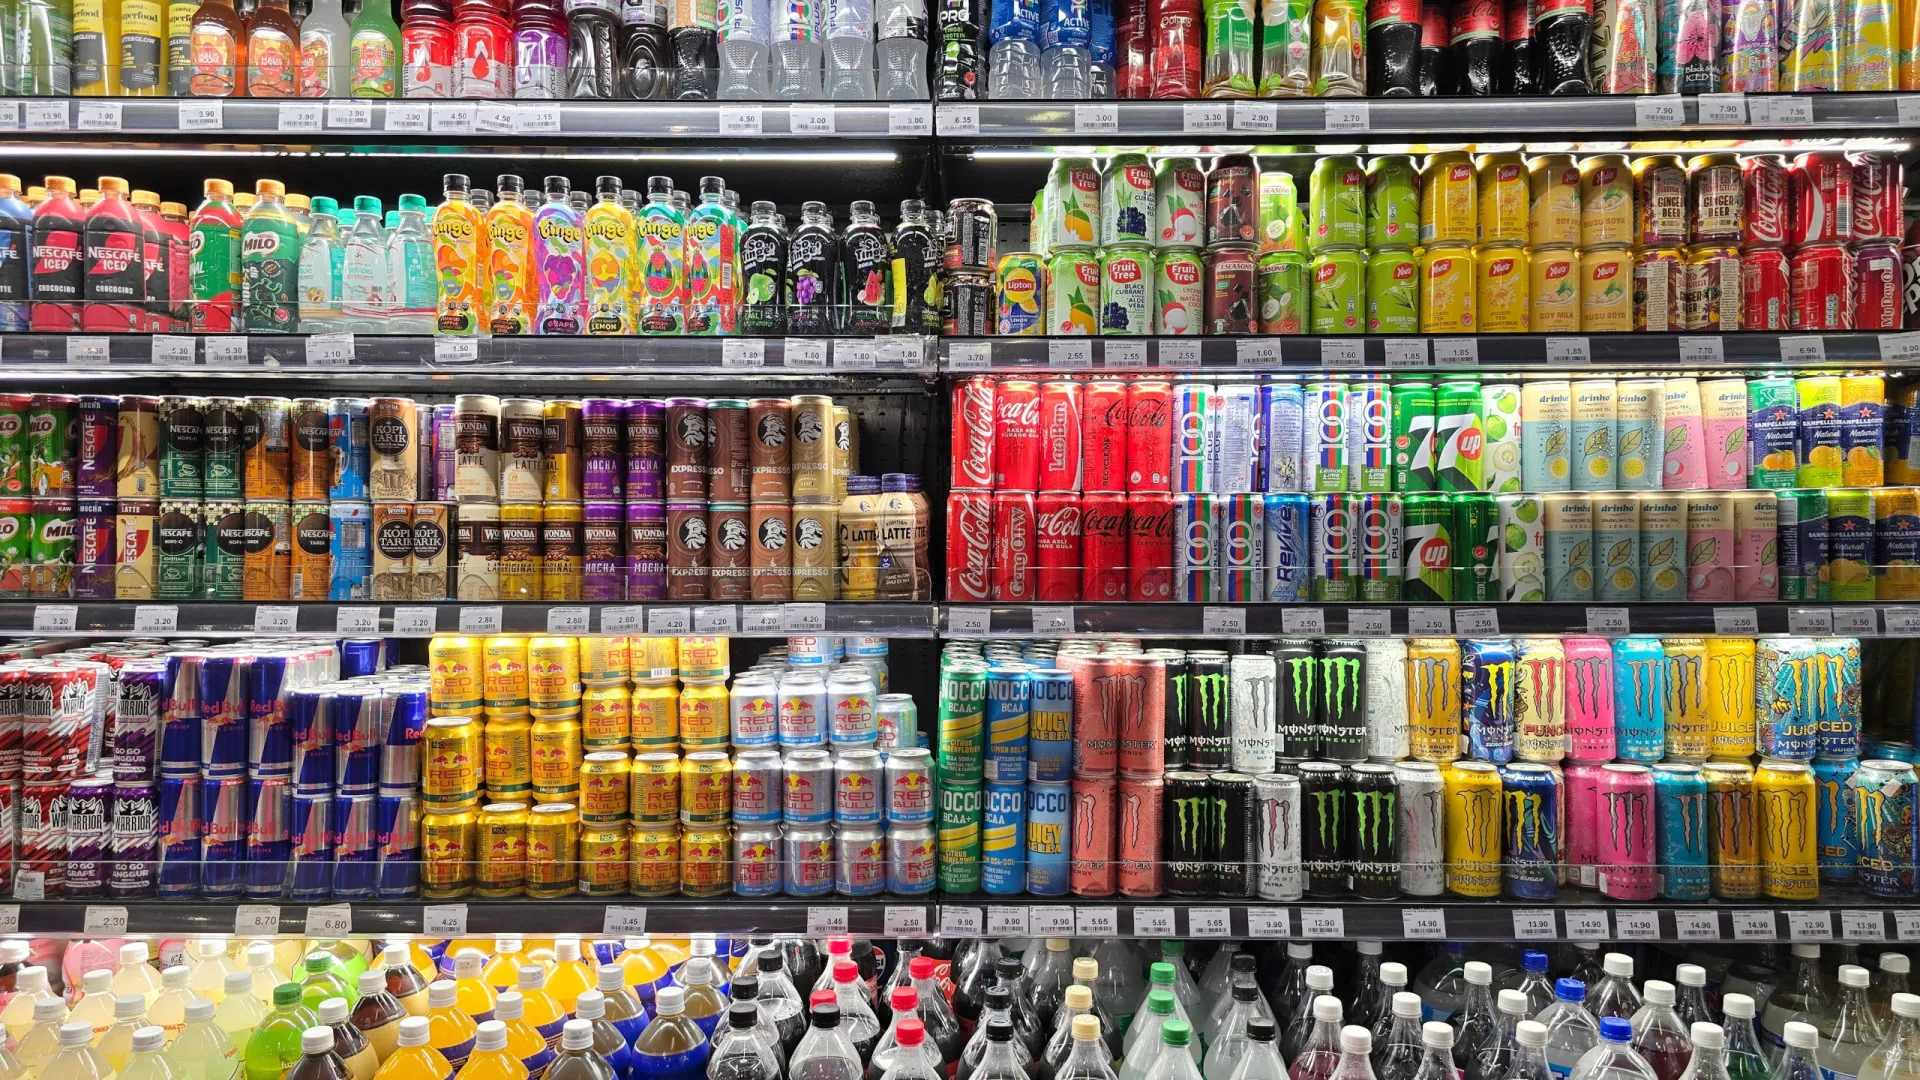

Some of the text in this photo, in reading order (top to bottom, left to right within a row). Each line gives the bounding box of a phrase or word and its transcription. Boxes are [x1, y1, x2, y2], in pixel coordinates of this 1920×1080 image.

[198, 110, 214, 118] 3.90
[1656, 106, 1674, 114] 7.90
[42, 112, 62, 120] 13.90
[98, 112, 114, 120] 3.90
[450, 112, 468, 120] 4.50
[908, 116, 924, 124] 3.00
[954, 116, 972, 124] 6.35
[1096, 114, 1112, 122] 3.00
[1252, 114, 1268, 122] 2.90
[1344, 114, 1360, 122] 2.70
[1131, 169, 1153, 178] Fruit
[1132, 177, 1151, 187] Tree
[1704, 197, 1734, 207] GINGER
[1662, 209, 1680, 218] BEER
[1709, 209, 1730, 217] BEER
[244, 237, 276, 251] MILO
[45, 260, 68, 270] ICED
[104, 261, 127, 270] ICED
[1112, 263, 1135, 272] Fruit
[1172, 265, 1195, 274] Fruit
[1114, 271, 1135, 279] Tree
[1174, 273, 1194, 282] Tree
[1007, 282, 1033, 292] Lipton
[226, 346, 242, 354] 5.30
[902, 350, 916, 358] 1.80
[1452, 348, 1470, 356] 1.85
[1800, 346, 1816, 354] 6.90
[804, 352, 820, 360] 1.80
[854, 352, 870, 360] 1.80
[968, 354, 984, 362] 3.70
[1068, 352, 1084, 360] 2.55
[1178, 352, 1194, 360] 2.55
[1404, 352, 1420, 360] 1.85
[376, 425, 403, 434] KOPI
[585, 426, 617, 436] WONDA
[373, 434, 406, 443] TARIK
[1462, 435, 1481, 452] up
[459, 456, 484, 465] LATTE
[587, 461, 617, 470] MOCHA
[1601, 504, 1634, 512] drinho
[1644, 504, 1677, 512] drinho
[383, 529, 410, 537] KOPI
[503, 529, 535, 540] WONDA
[585, 529, 616, 539] WONDA
[1391, 528, 1399, 559] PLUS
[1833, 541, 1864, 551] Naturali
[1425, 545, 1447, 561] up
[272, 618, 288, 626] 3.20
[618, 616, 634, 624] 2.80
[712, 618, 726, 626] 4.20
[966, 620, 980, 628] 2.50
[1300, 620, 1316, 628] 2.50
[1476, 620, 1492, 628] 2.50
[1734, 618, 1750, 626] 2.50
[1808, 618, 1824, 626] 9.50
[1852, 618, 1870, 626] 9.50
[1366, 622, 1382, 630] 2.50
[435, 677, 471, 687] RED
[1001, 703, 1023, 713] BCAA
[589, 717, 626, 726] RED
[835, 713, 871, 722] RED
[590, 726, 624, 734] BULL
[836, 723, 872, 731] BULL
[838, 791, 874, 800] RED
[894, 790, 930, 800] RED
[838, 801, 874, 809] BULL
[894, 800, 930, 808] BULL
[116, 815, 150, 831] WARRIOR
[113, 869, 149, 877] ANGGUR
[103, 917, 125, 926] 2.30
[254, 916, 276, 925] 8.70
[442, 918, 458, 926] 4.25
[958, 918, 974, 926] 9.90
[1052, 918, 1070, 926] 9.90
[1528, 920, 1548, 928] 13.90
[1580, 920, 1602, 928] 14.90
[324, 920, 346, 930] 6.80
[1856, 922, 1876, 930] 13.90
